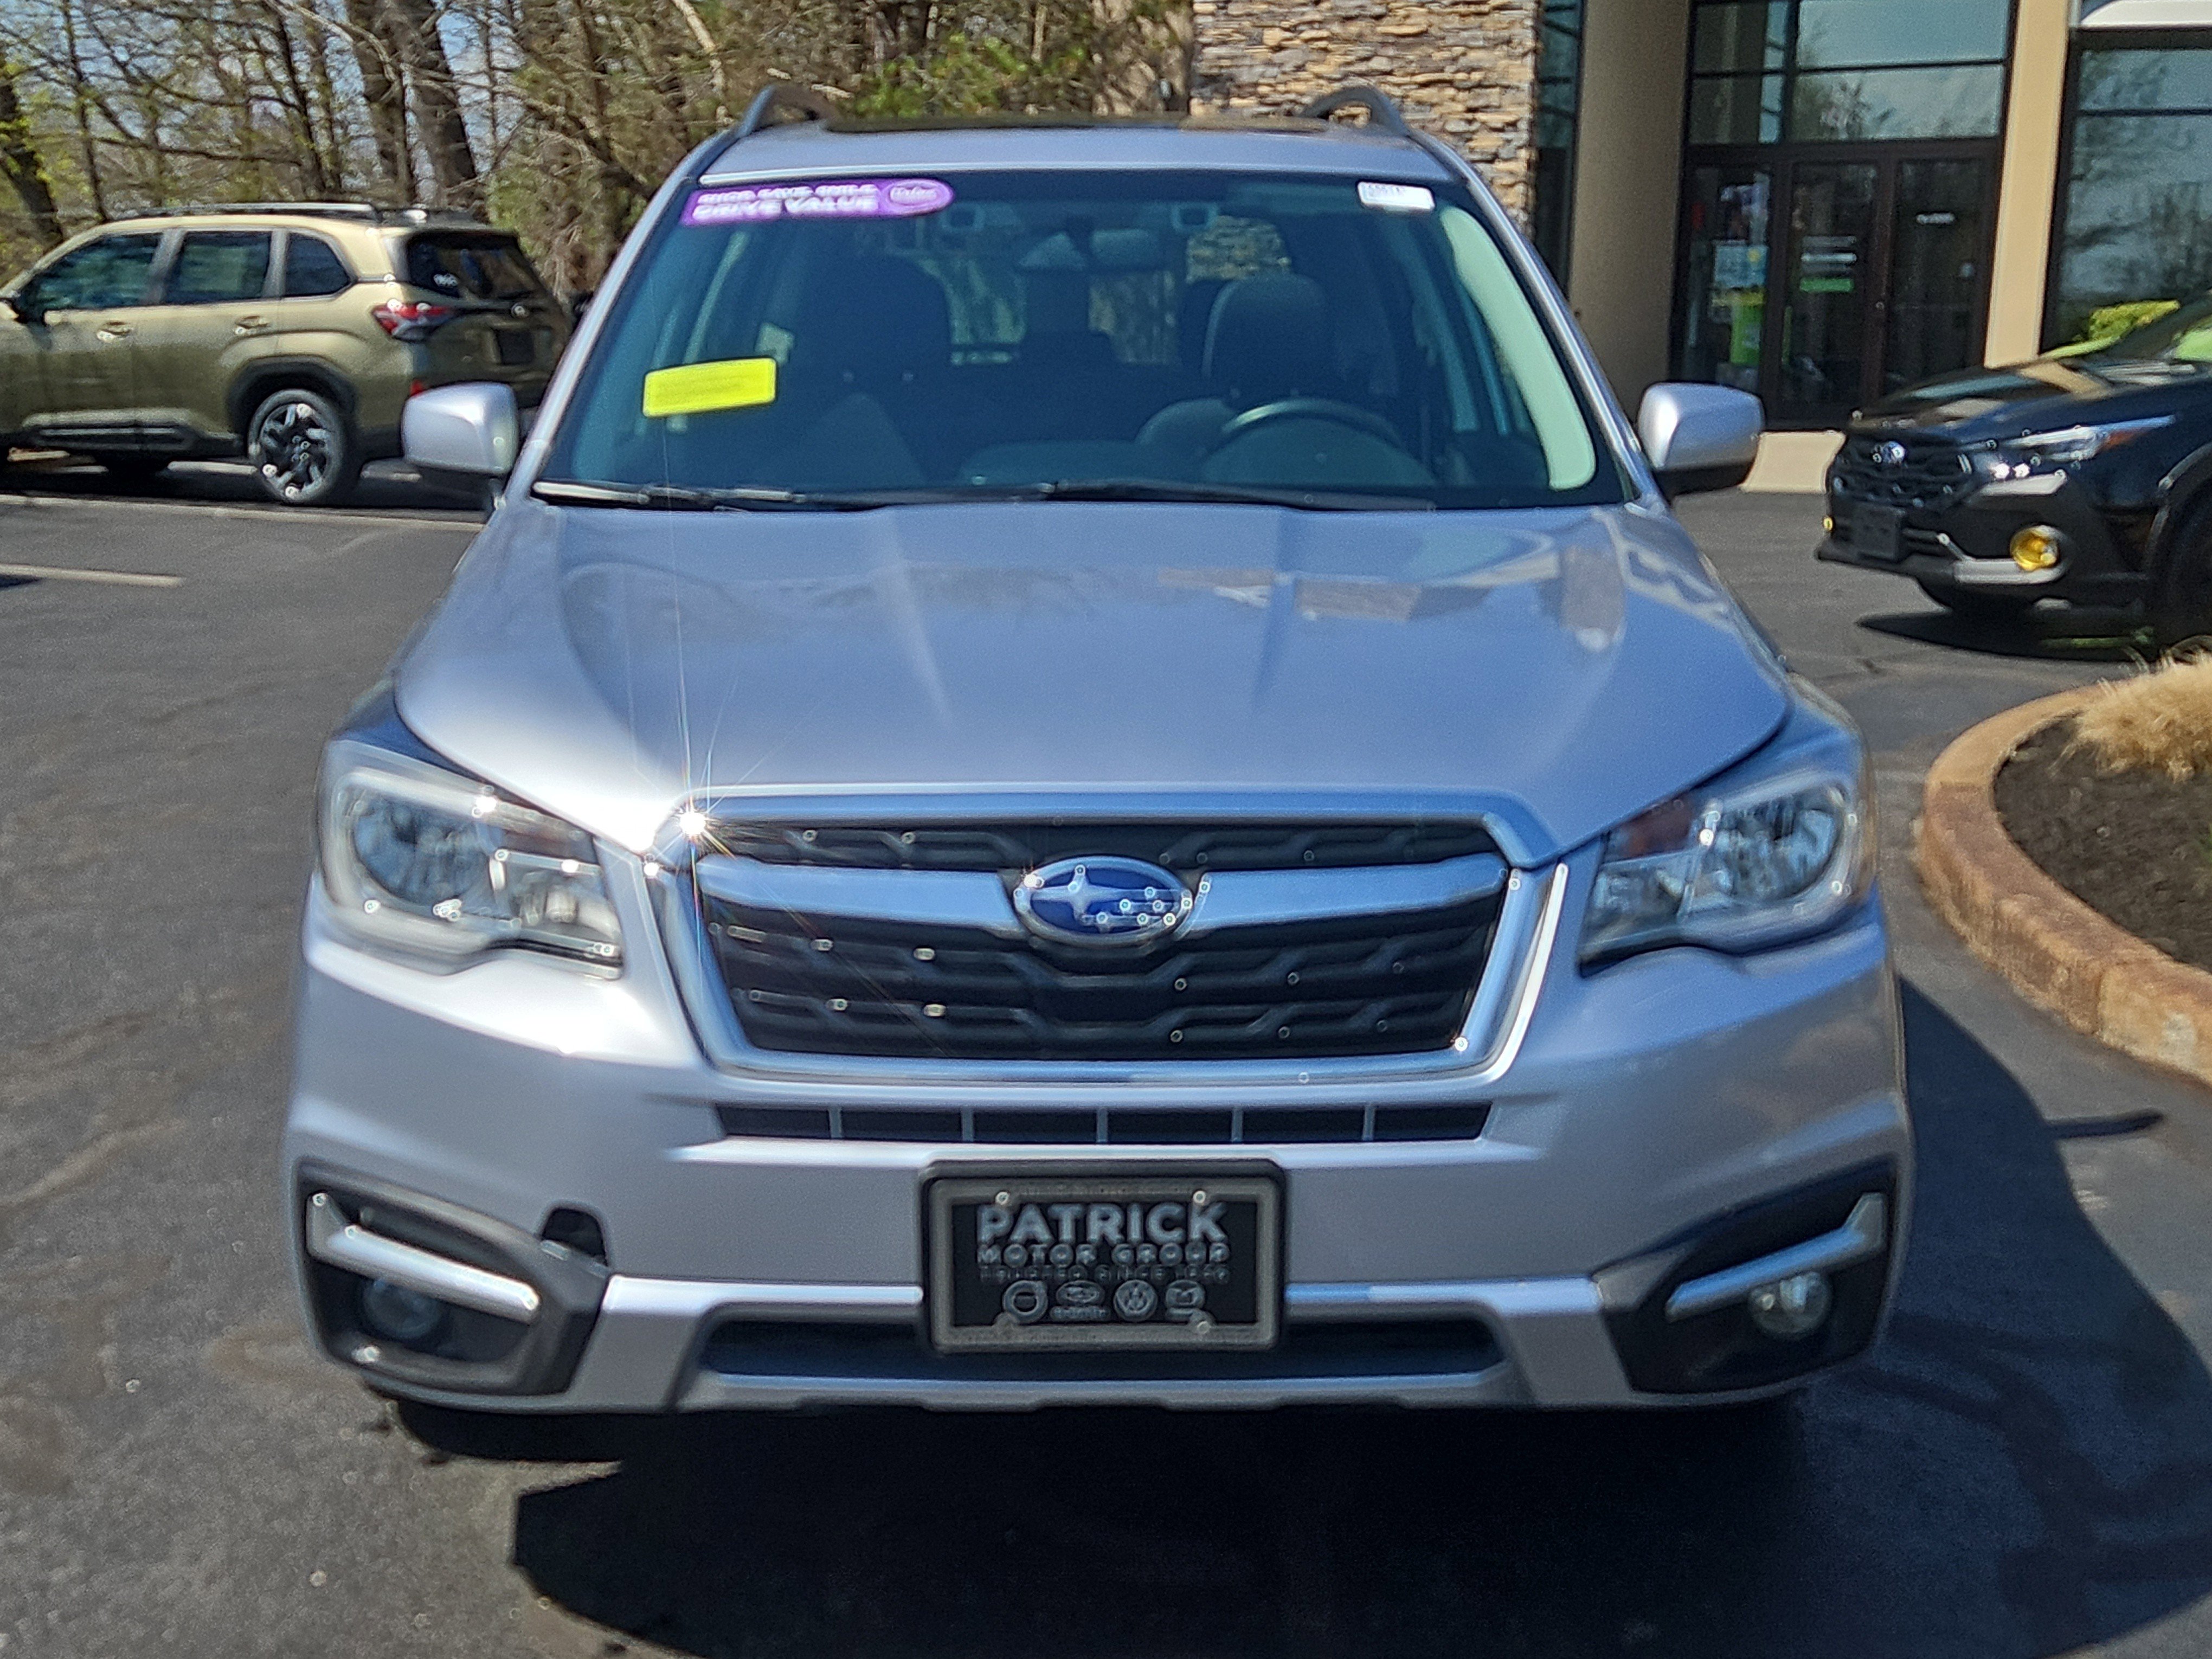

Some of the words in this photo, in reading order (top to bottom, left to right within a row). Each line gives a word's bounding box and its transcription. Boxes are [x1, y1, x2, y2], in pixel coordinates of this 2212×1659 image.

[785, 196, 879, 215] VALUE
[978, 1203, 1229, 1245] PATRICK
[978, 1244, 1096, 1268] MOTOR
[1111, 1243, 1231, 1266] GROUP
